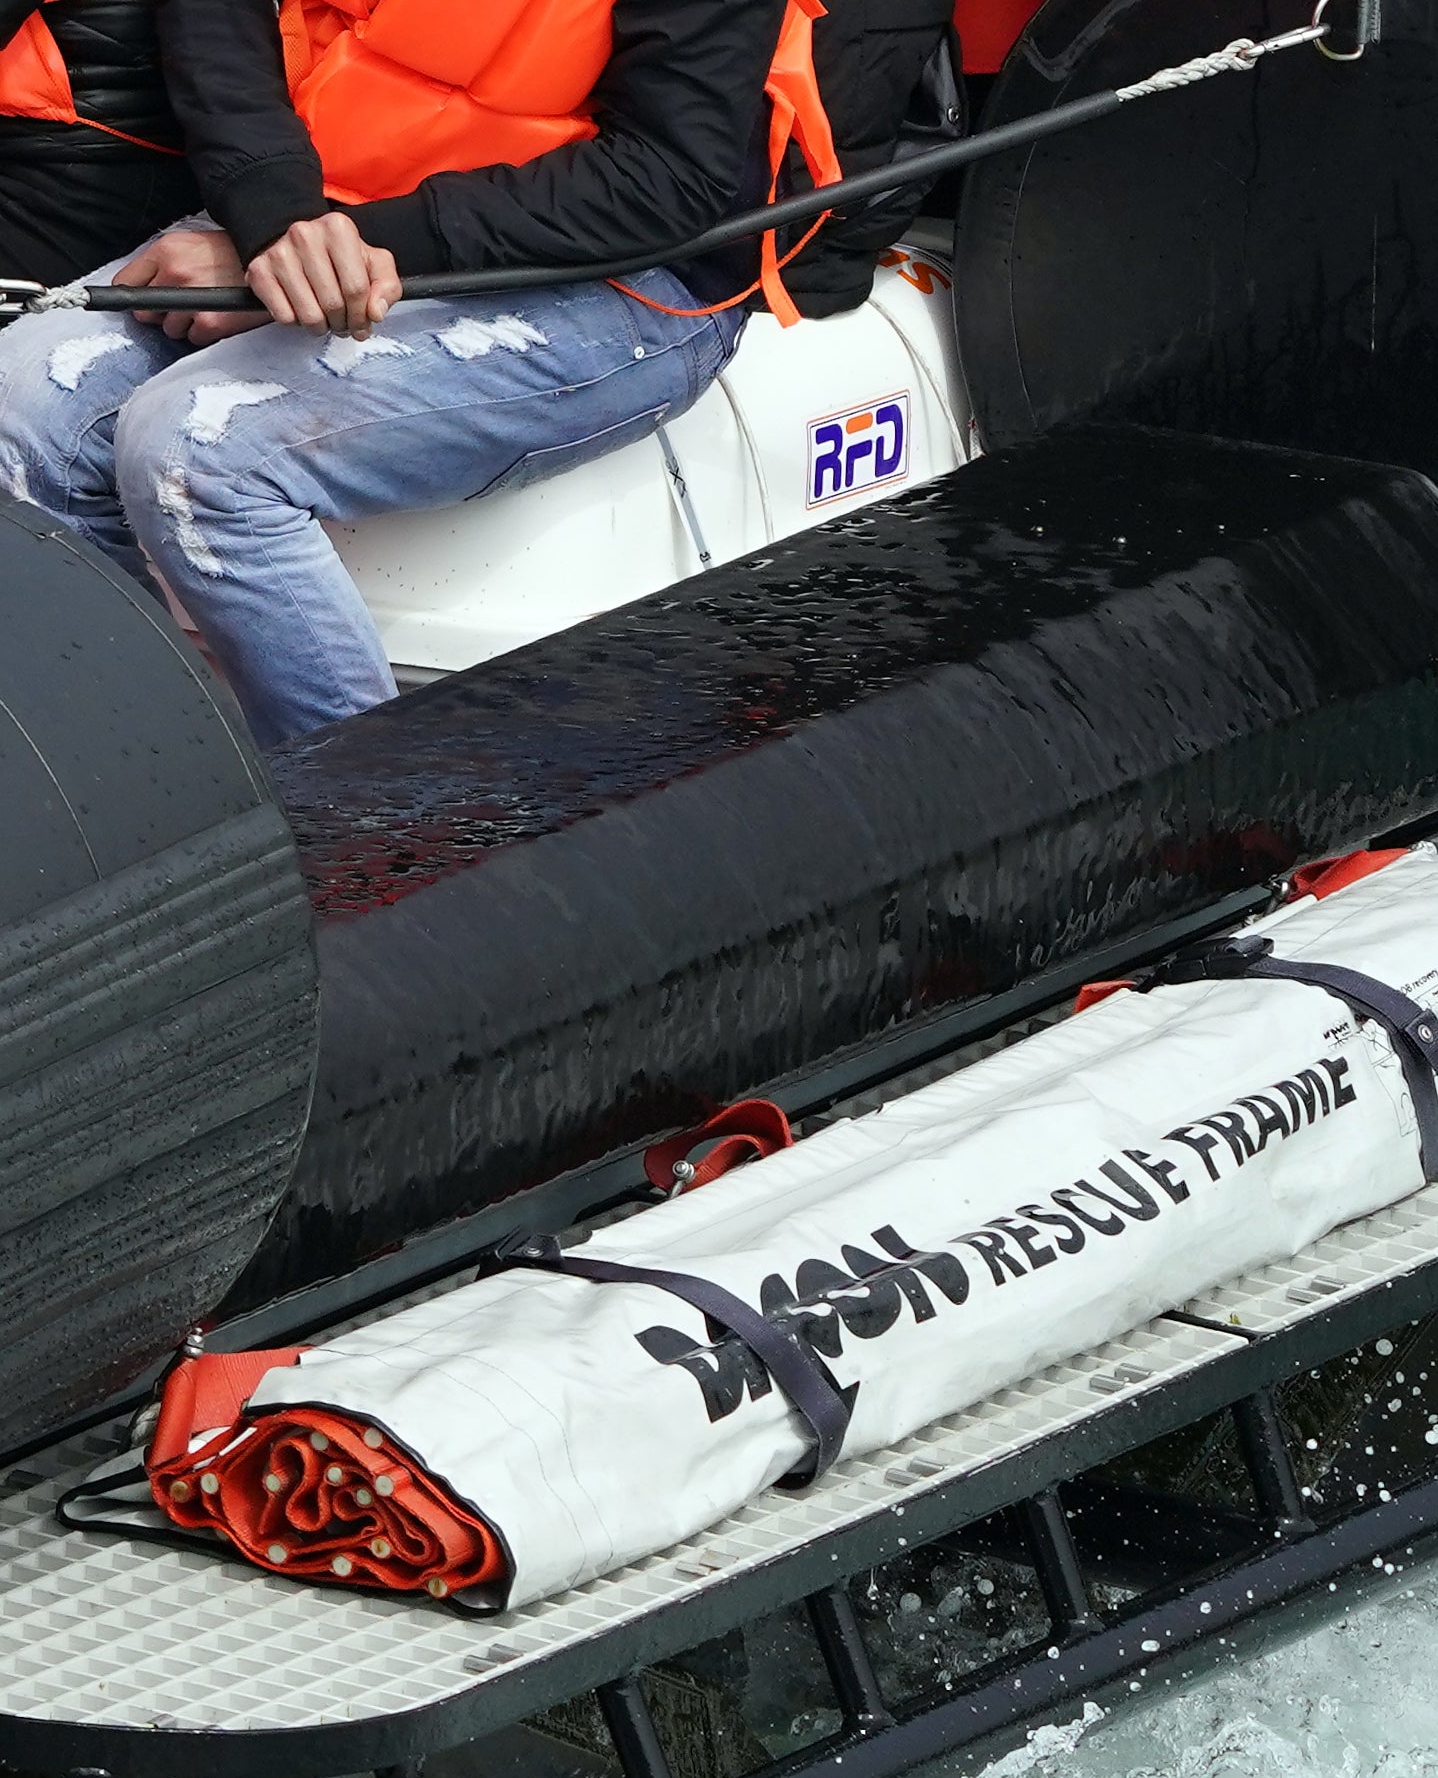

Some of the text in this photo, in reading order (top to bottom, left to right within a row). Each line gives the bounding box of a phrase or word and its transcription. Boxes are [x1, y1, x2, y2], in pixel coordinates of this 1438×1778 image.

[814, 404, 904, 499] RFD
[949, 1149, 1190, 1286] RESCUE
[1161, 1055, 1357, 1182] FRAME
